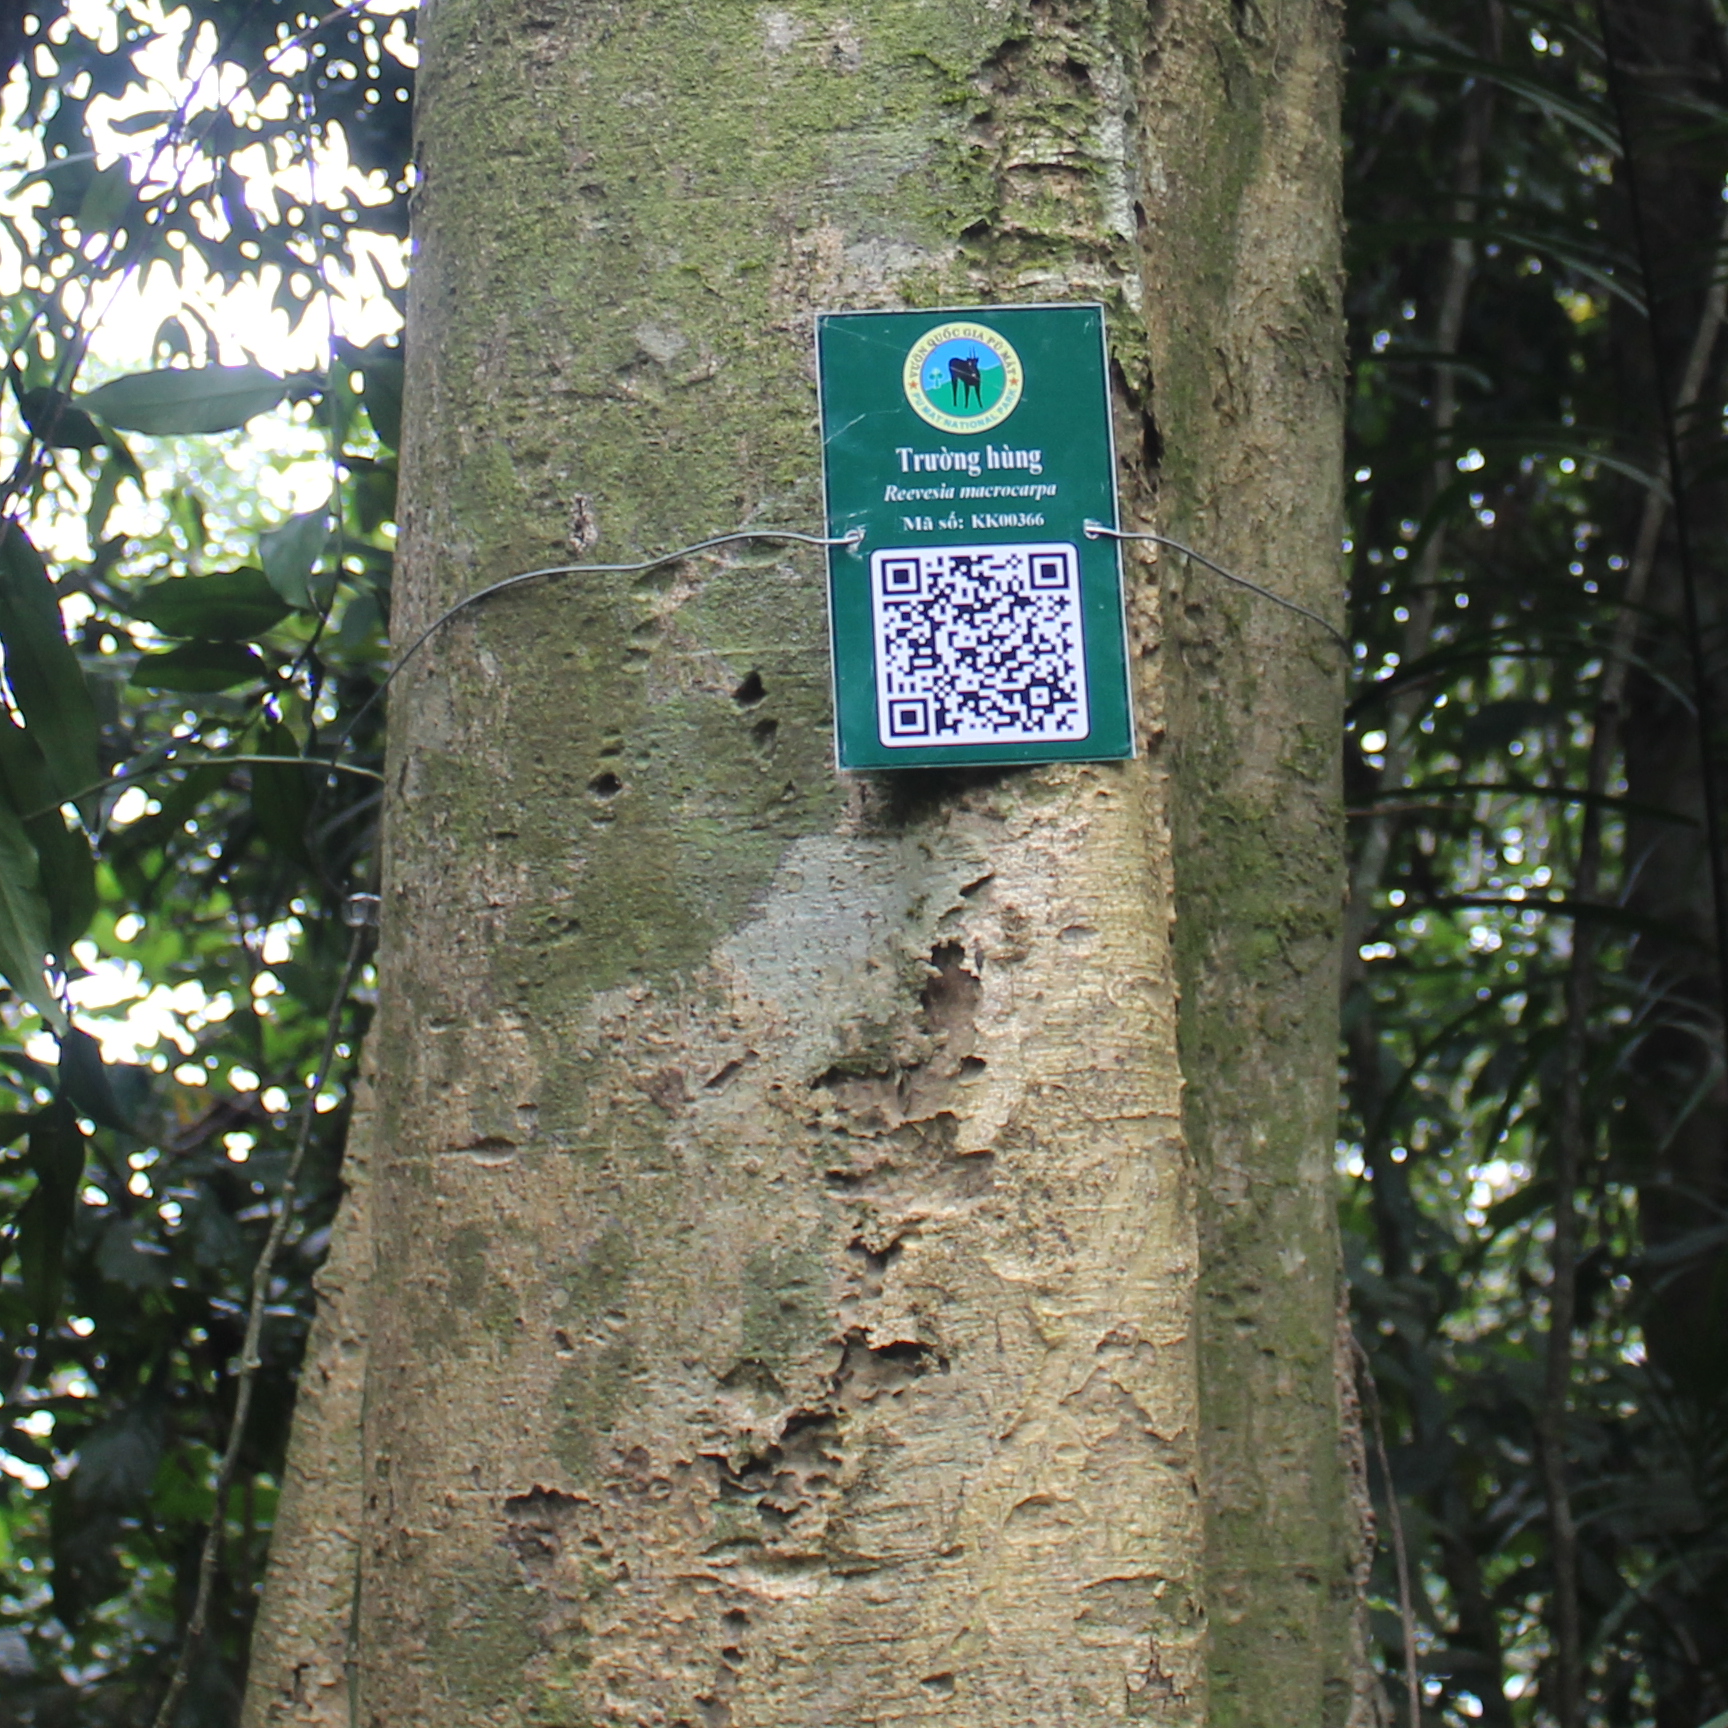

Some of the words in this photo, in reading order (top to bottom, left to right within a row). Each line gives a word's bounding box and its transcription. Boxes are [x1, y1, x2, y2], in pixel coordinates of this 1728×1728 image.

[963, 328, 984, 341] GIA
[922, 405, 942, 422] MAT
[944, 414, 999, 429] NATIONAL
[997, 389, 1016, 414] PARK
[895, 446, 982, 477] Trường
[986, 444, 1043, 475] hùng
[883, 482, 955, 502] Reevesia
[959, 483, 1057, 501] macrocarpa
[903, 515, 934, 532] Mã
[938, 511, 964, 530] số:
[971, 512, 1045, 529] KK00366
